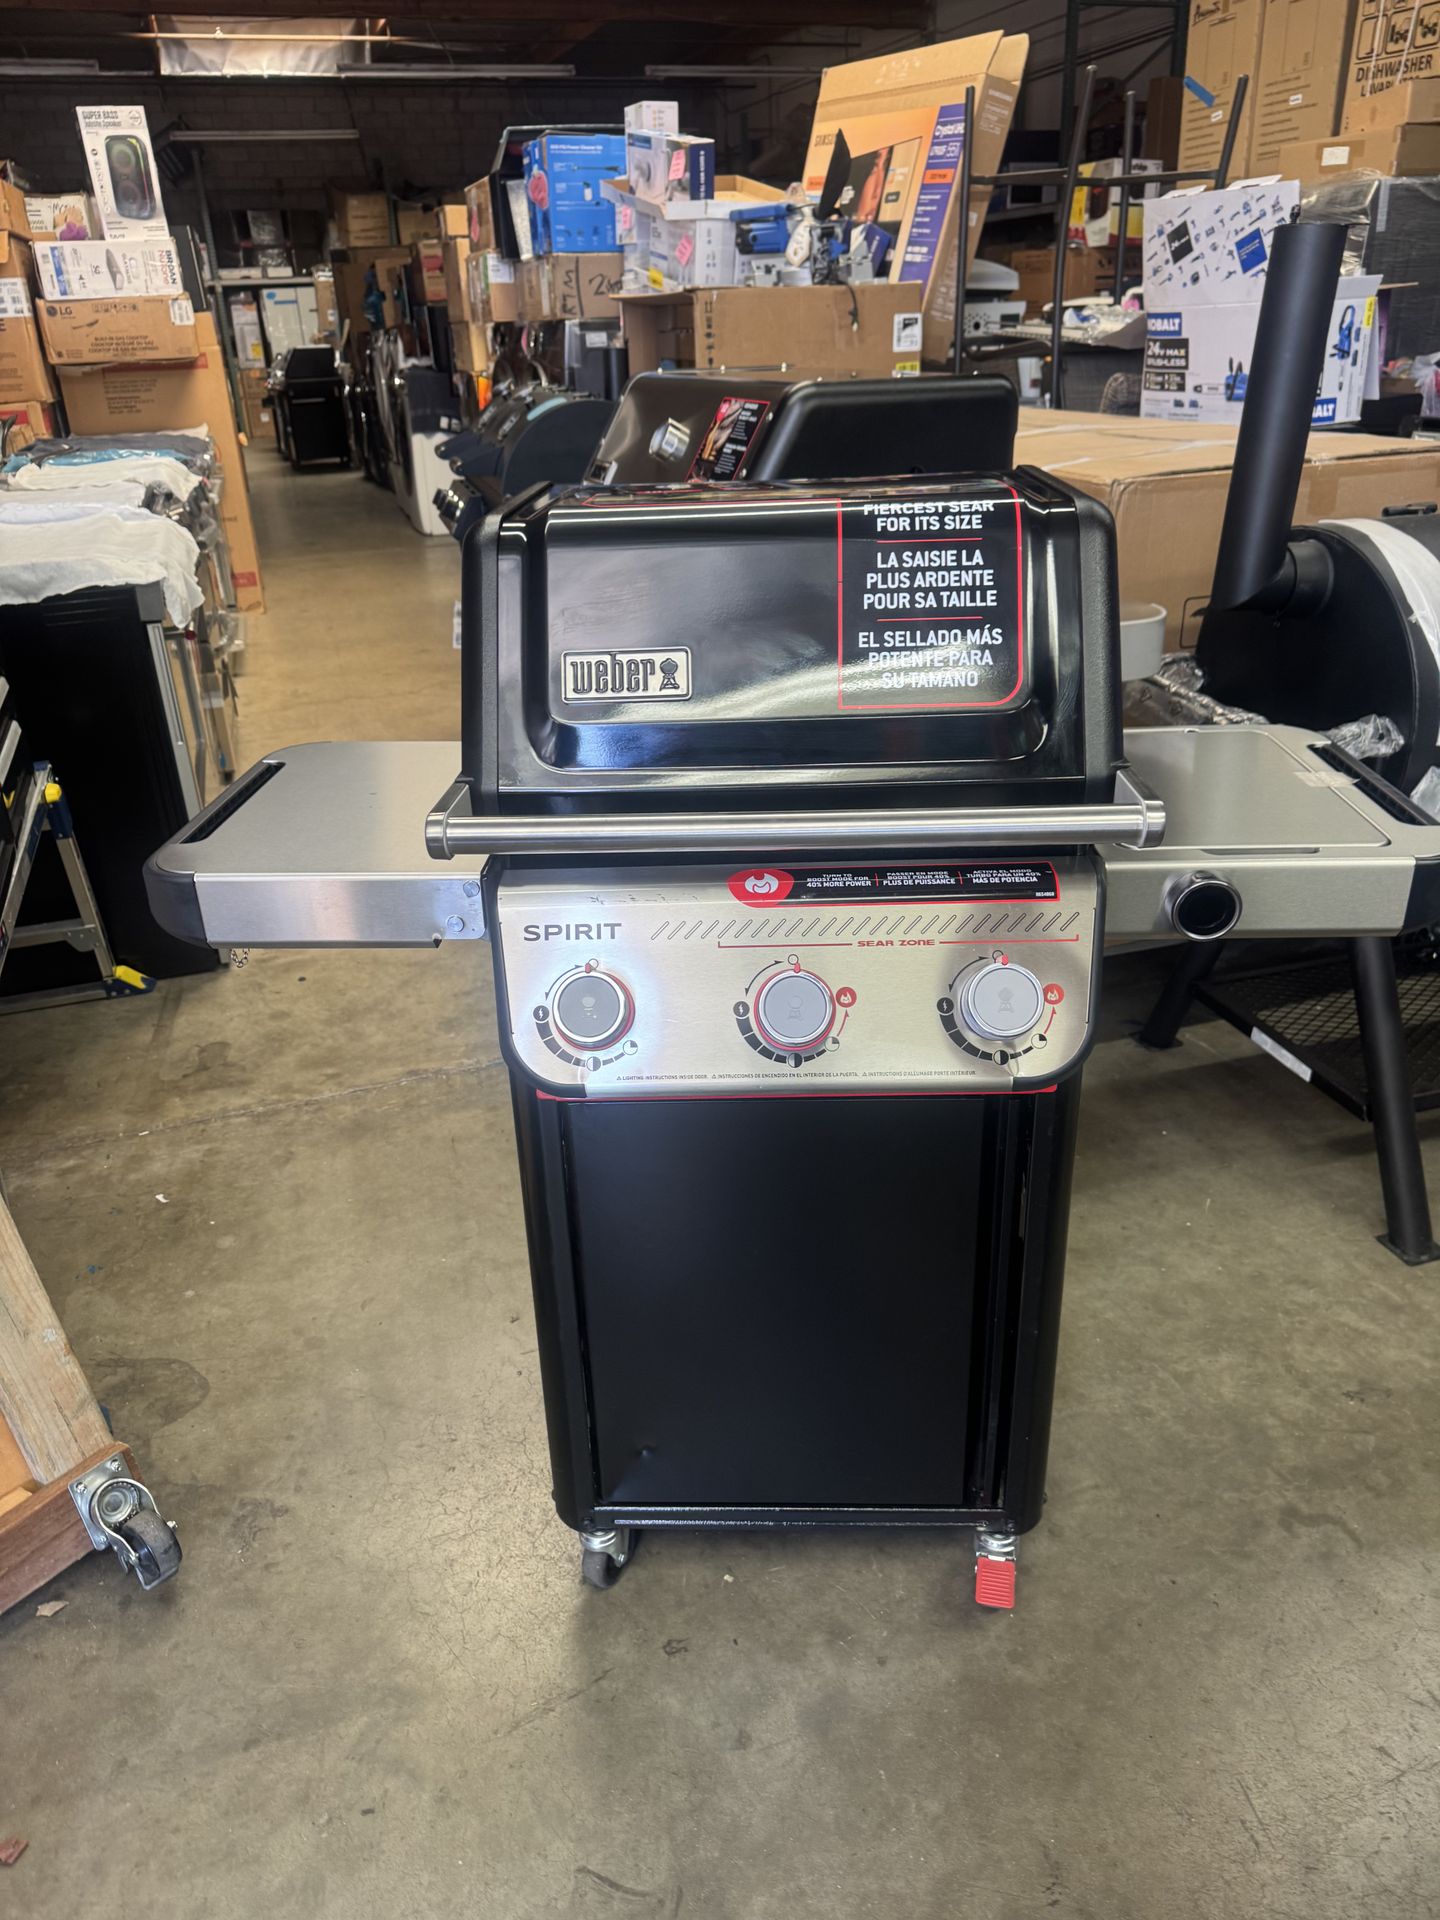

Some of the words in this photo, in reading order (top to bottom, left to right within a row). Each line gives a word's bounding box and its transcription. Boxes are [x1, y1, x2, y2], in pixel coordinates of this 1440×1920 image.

[165, 250, 177, 285] BROAN
[59, 306, 73, 316] LG
[1312, 403, 1335, 418] ALT
[864, 502, 944, 516] FIERCEST
[949, 500, 995, 513] SEAR
[876, 517, 911, 532] FOR
[915, 516, 940, 530] ITS
[944, 514, 983, 530] SIZE
[876, 552, 898, 568] LA
[902, 550, 957, 568] SAISIE
[961, 549, 984, 566] LA
[866, 572, 910, 589] PLUS
[913, 569, 994, 588] ARDENTE
[863, 593, 910, 610] POUR
[914, 592, 938, 609] SA
[940, 590, 997, 608] TAILLE
[858, 632, 880, 648] EL
[883, 629, 962, 647] SELLADO
[967, 624, 1003, 645] MÁS
[868, 651, 945, 669] POTENTE
[950, 649, 993, 667] PARA
[570, 652, 656, 694] weber
[881, 672, 905, 689] SU
[523, 922, 622, 942] SPIRIT
[856, 939, 895, 947] SEAR
[898, 938, 935, 946] ZONE
